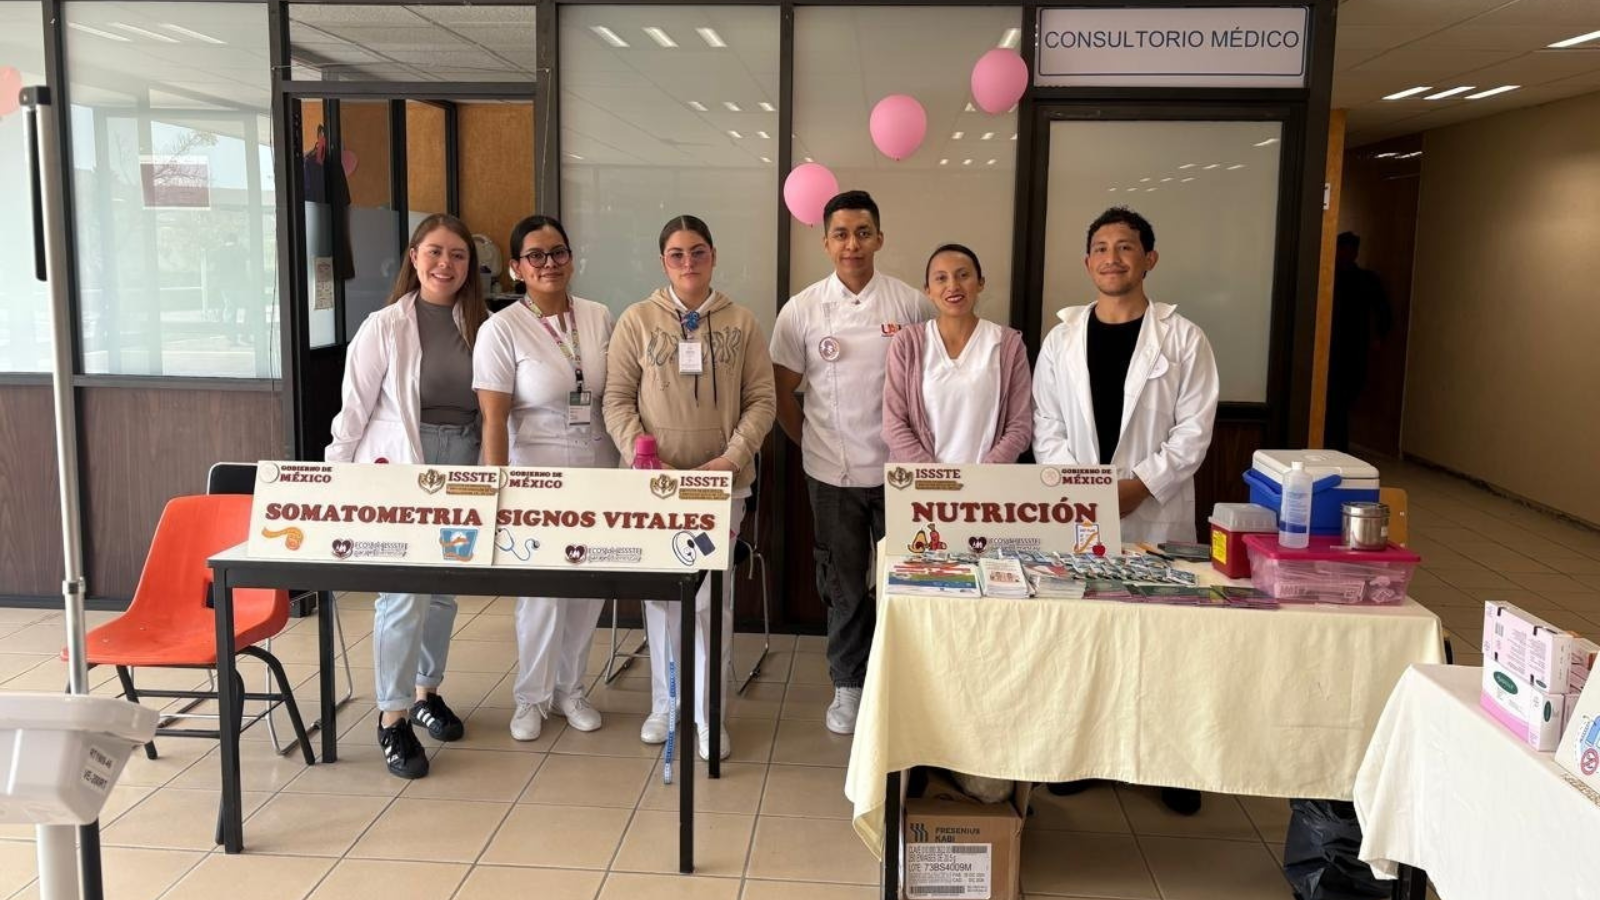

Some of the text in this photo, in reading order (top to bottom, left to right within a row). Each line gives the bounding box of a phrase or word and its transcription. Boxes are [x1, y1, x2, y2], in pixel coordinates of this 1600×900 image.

[1044, 26, 1300, 49] CONSULTORIO MÉDICO
[280, 465, 320, 473] GOBIERNO
[509, 470, 551, 478] GOBIERNO
[915, 468, 961, 479] ISSSTE
[280, 472, 332, 484] MÉXICO
[448, 471, 497, 483] ISSSTE
[509, 477, 563, 489] MÉXICO
[680, 476, 729, 488] ISSSTE
[1061, 473, 1112, 486] MÉXICO
[265, 503, 483, 526] SOMATOMETRIA
[911, 496, 1098, 524] NUTRICIÓN
[497, 509, 716, 531] SIGNOS VITALES
[934, 835, 956, 843] KABI
